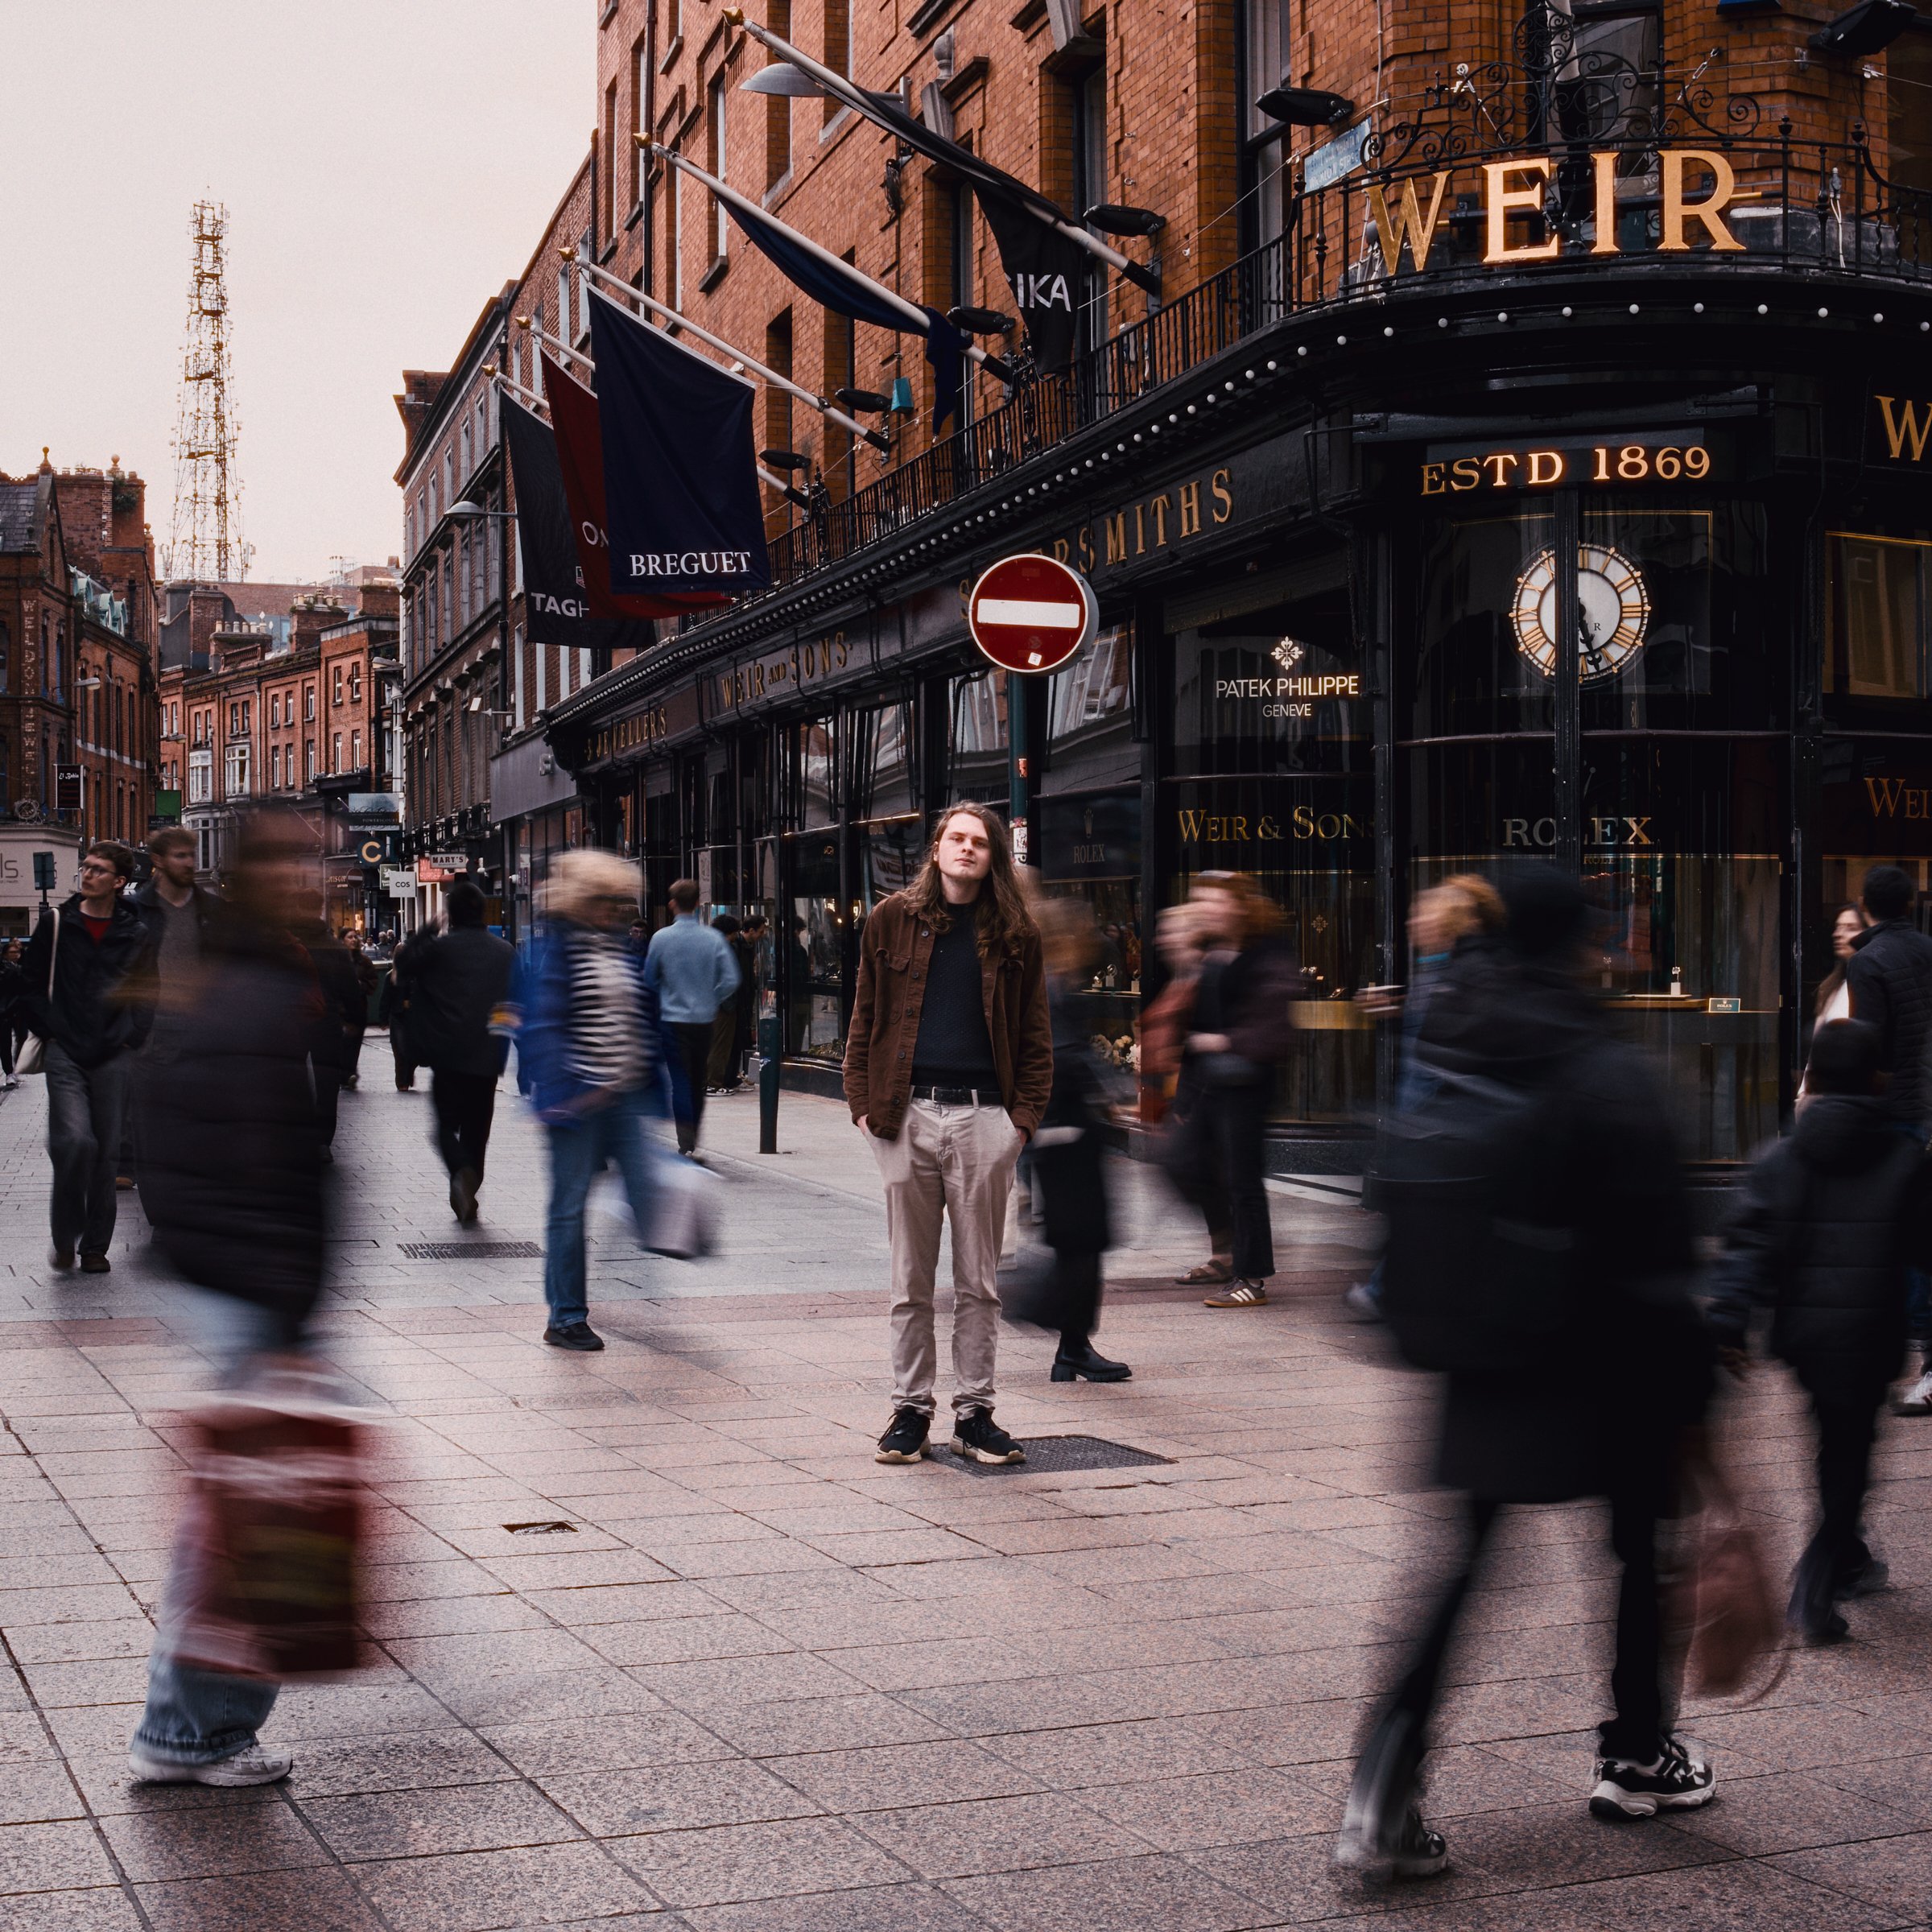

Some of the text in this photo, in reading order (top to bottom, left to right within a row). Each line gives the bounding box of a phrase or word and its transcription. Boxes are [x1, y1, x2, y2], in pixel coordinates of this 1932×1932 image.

[1363, 150, 1746, 276] WEIR
[1016, 273, 1072, 312] IKA
[1593, 446, 1711, 481] 1869
[629, 551, 751, 577] BREGUET
[720, 663, 766, 708] WEIR
[768, 662, 786, 684] AND
[1216, 675, 1360, 699] PATEK PHILIPPE
[1262, 703, 1312, 718] GENEVE
[1256, 815, 1286, 841] &
[1502, 815, 1656, 847] ROEX
[432, 856, 464, 864] MARY'S
[1073, 844, 1105, 865] ROLEX
